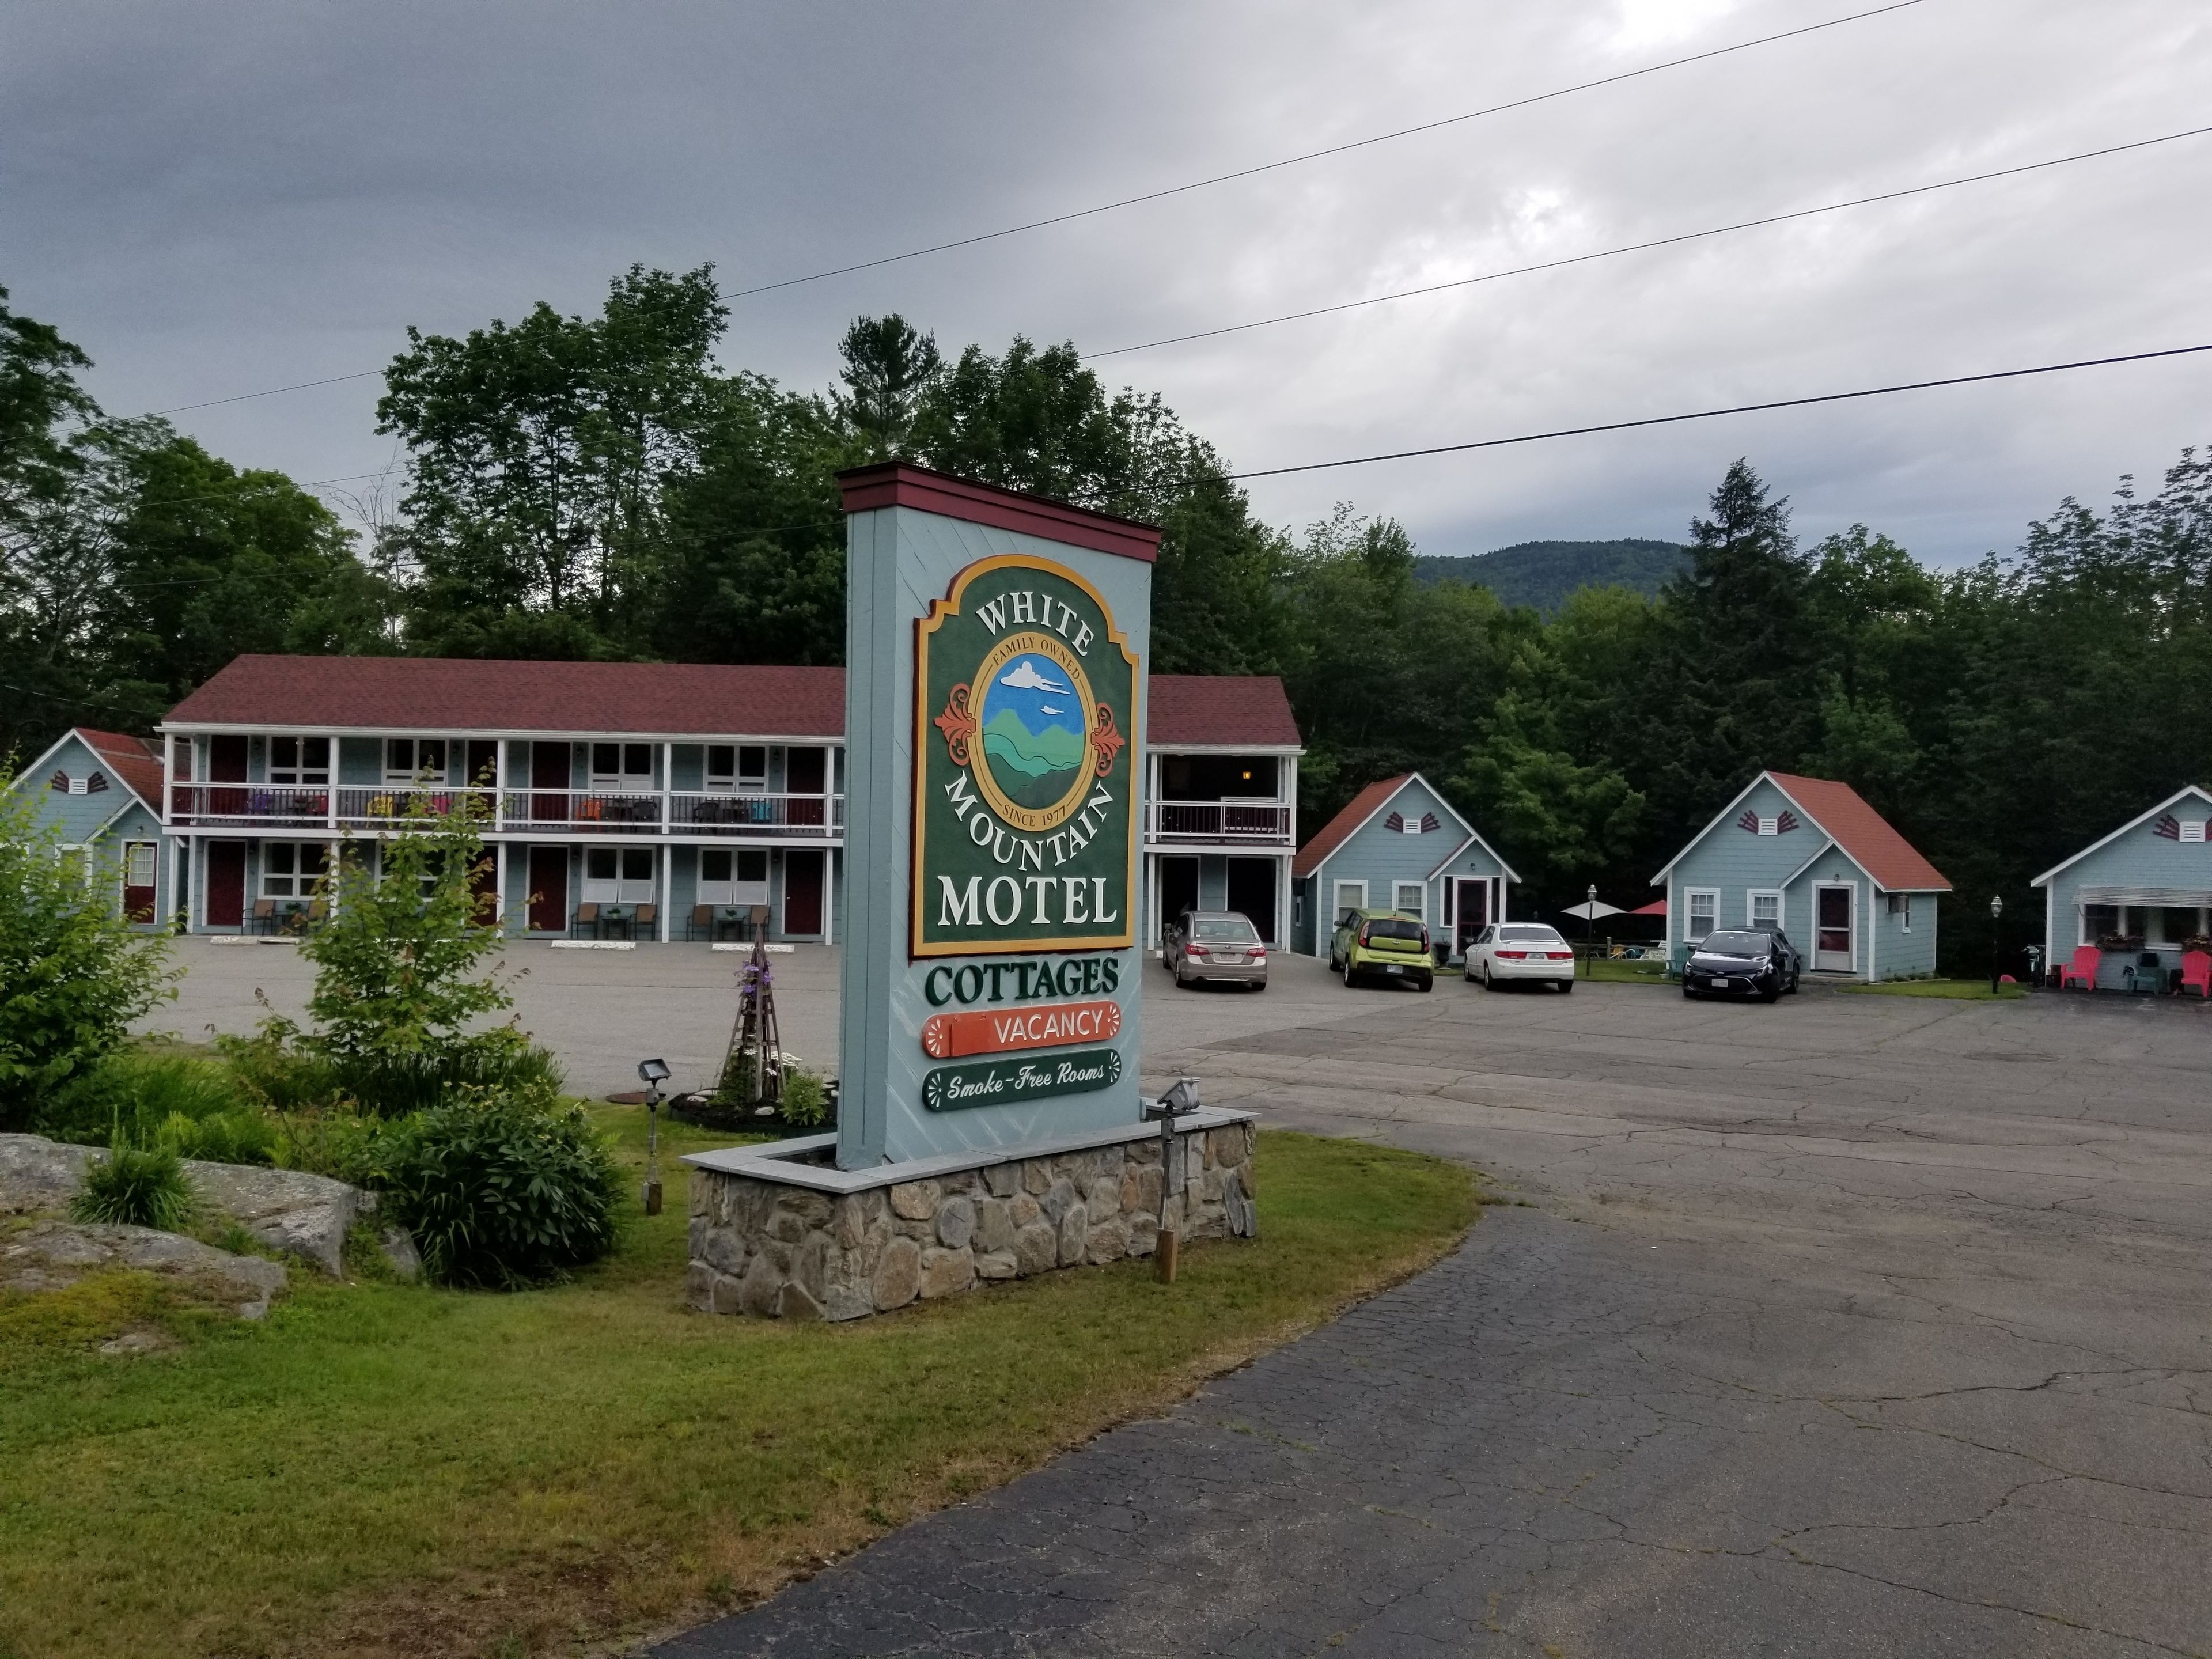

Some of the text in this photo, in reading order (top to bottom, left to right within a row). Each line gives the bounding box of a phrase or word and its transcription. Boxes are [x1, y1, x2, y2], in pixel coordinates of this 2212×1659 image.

[976, 591, 1094, 656] WHITE
[993, 637, 1080, 679] FAMILY OWNED
[945, 770, 1114, 871] MOUNTAIN
[1003, 804, 1065, 827] SINCE 1977
[937, 876, 1117, 926] MOTEL
[925, 957, 1119, 1006] COTTAGES
[994, 1009, 1103, 1043] VACANCY
[947, 1062, 1104, 1099] Smoke-Free Rooms
